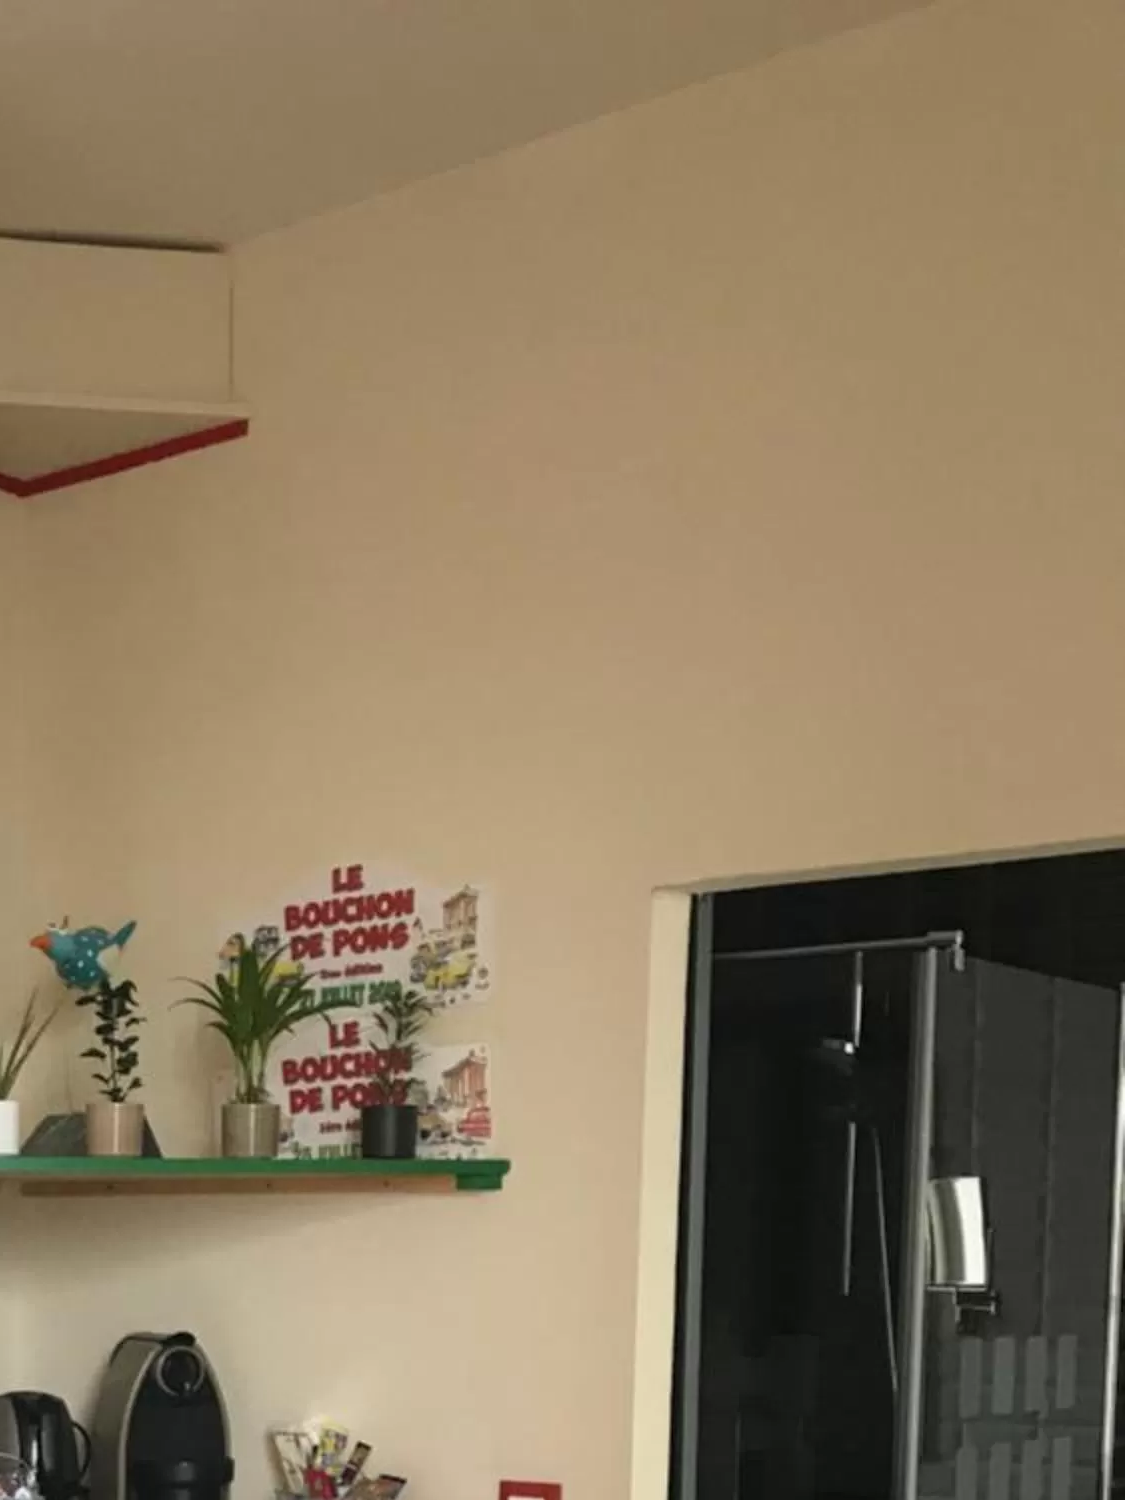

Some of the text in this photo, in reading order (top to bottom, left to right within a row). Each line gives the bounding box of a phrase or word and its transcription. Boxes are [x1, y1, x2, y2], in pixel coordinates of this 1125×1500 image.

[332, 864, 364, 894] LE
[284, 887, 415, 932] BOUCHON
[290, 921, 409, 961] DE PONS
[329, 1021, 361, 1049] LE
[282, 1046, 413, 1085] BOUCHON
[289, 1087, 323, 1114] DE
